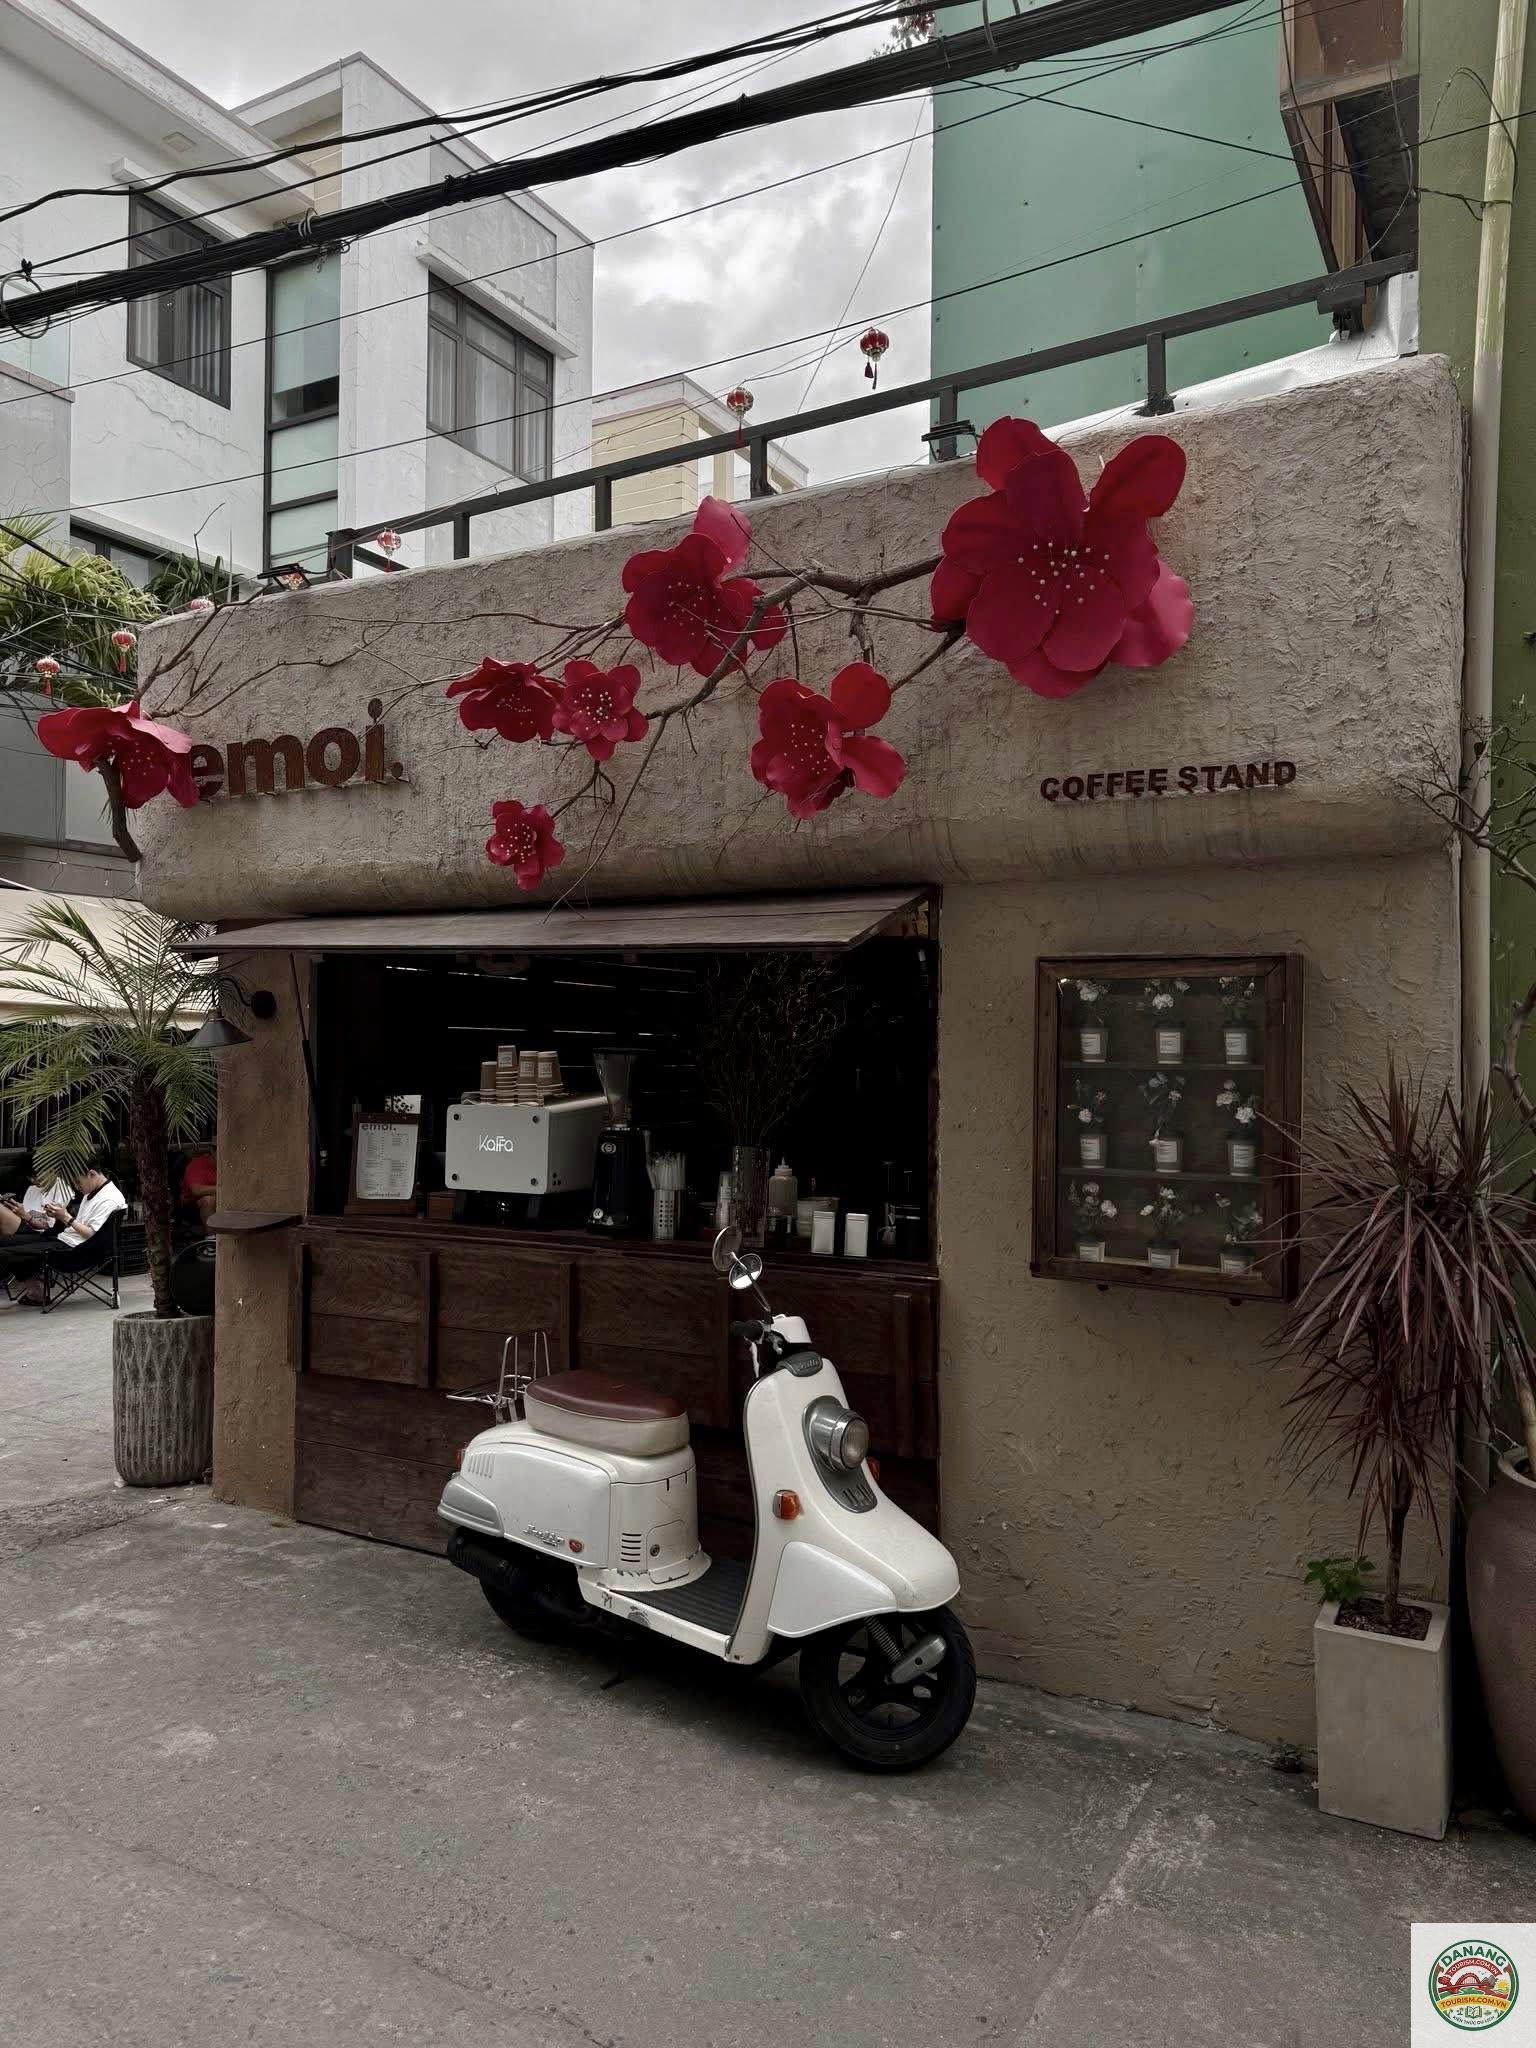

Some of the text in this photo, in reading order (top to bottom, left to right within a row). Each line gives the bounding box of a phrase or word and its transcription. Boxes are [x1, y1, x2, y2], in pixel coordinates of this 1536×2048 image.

[189, 697, 404, 799] emoi.
[1040, 761, 1297, 800] COFFEE STAND
